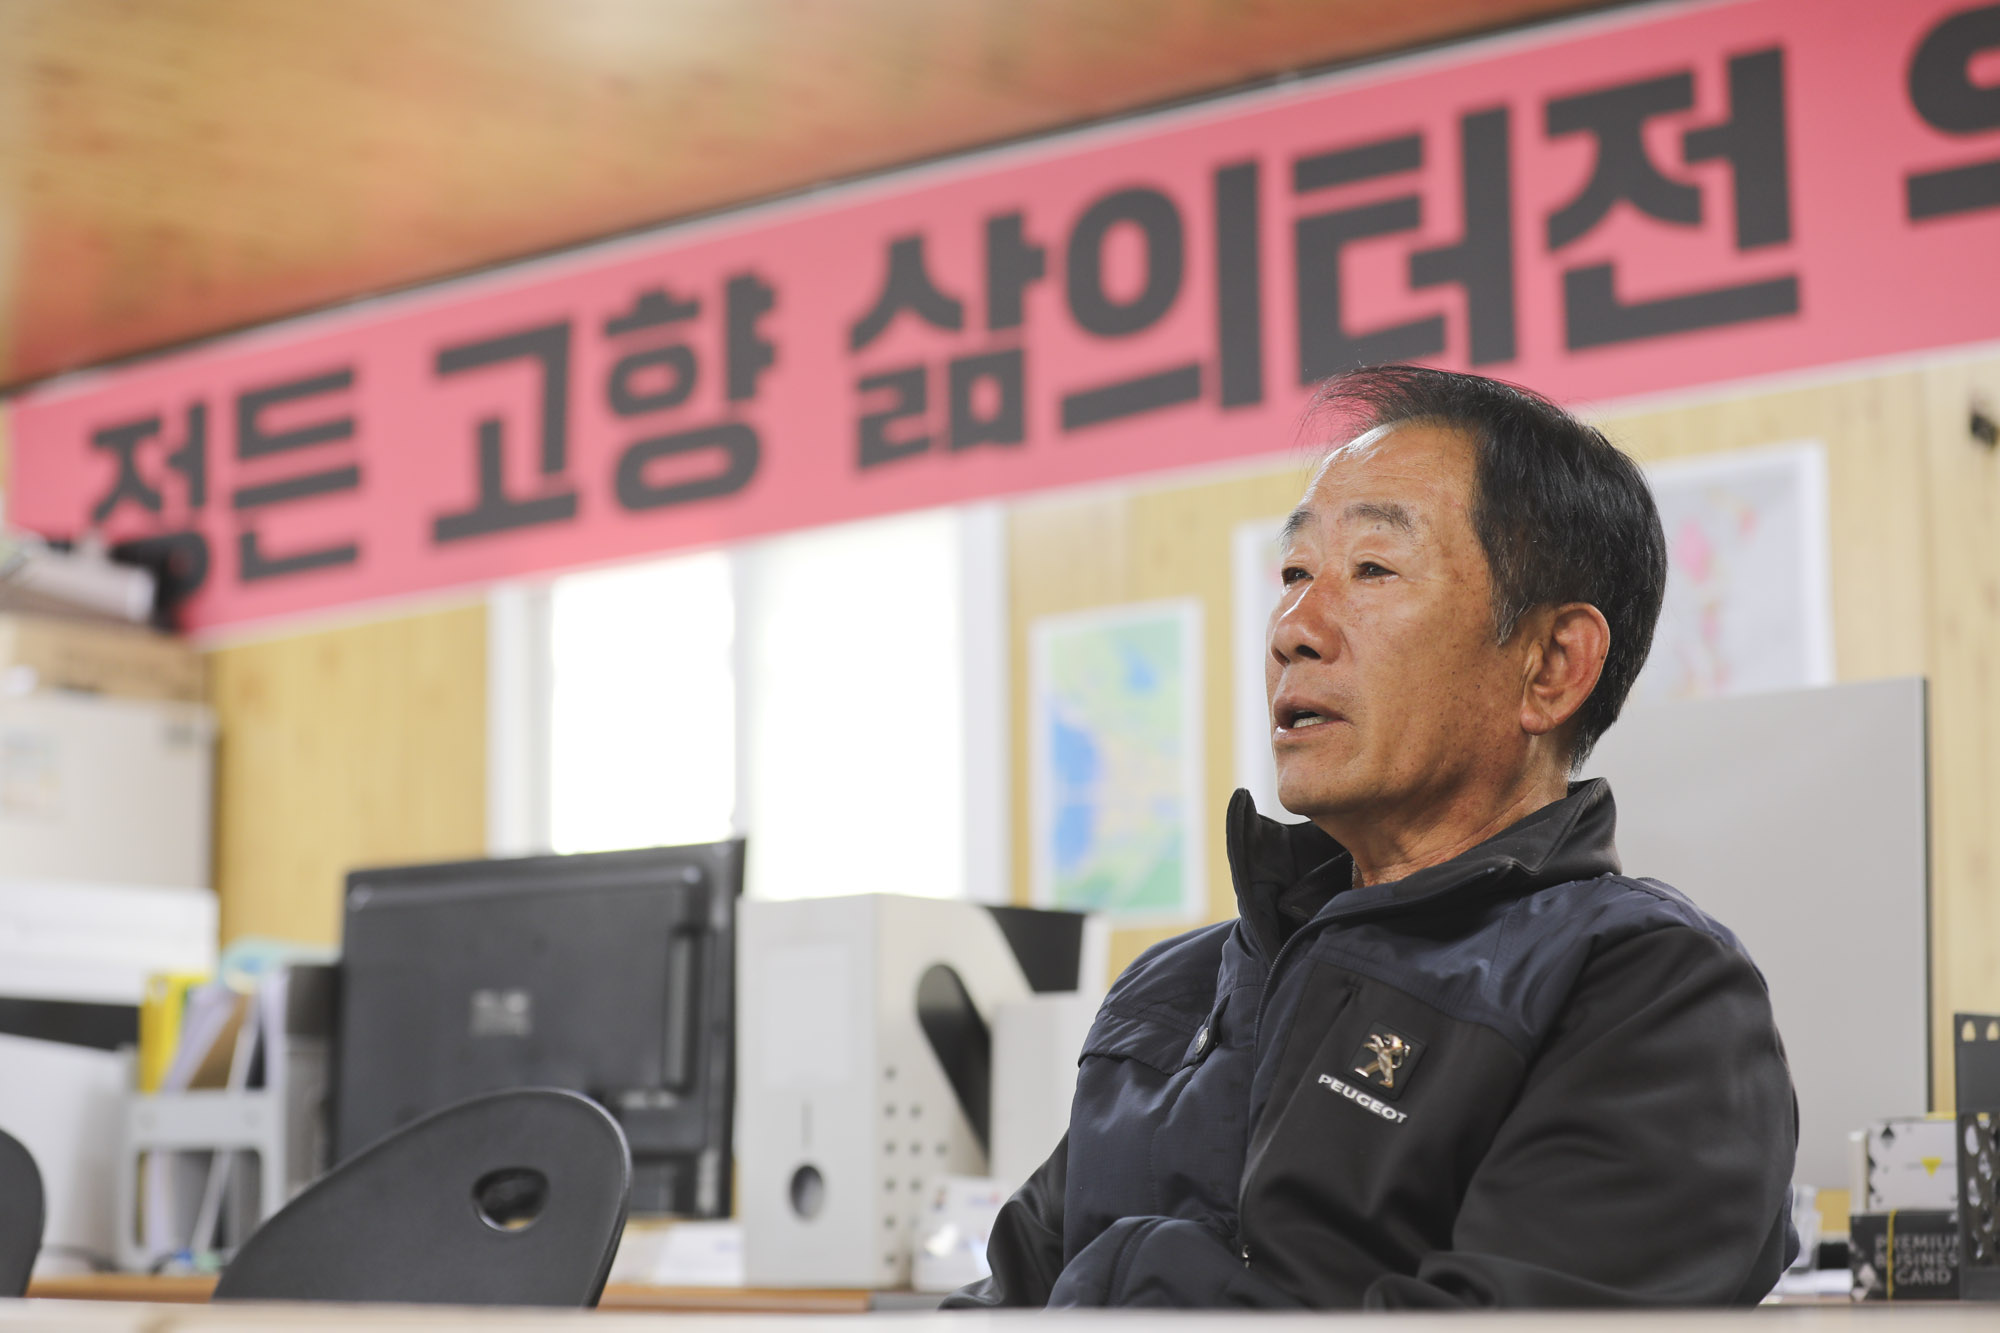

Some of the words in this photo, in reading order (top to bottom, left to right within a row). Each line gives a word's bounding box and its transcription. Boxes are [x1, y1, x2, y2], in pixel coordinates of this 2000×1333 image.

[90, 365, 363, 600] 정든
[432, 274, 776, 545] 고향
[848, 43, 1801, 471] 삶의터전
[1318, 1073, 1408, 1123] PEUGEOT
[1875, 1252, 1960, 1268] BUSINES
[1895, 1269, 1952, 1285] CARD
